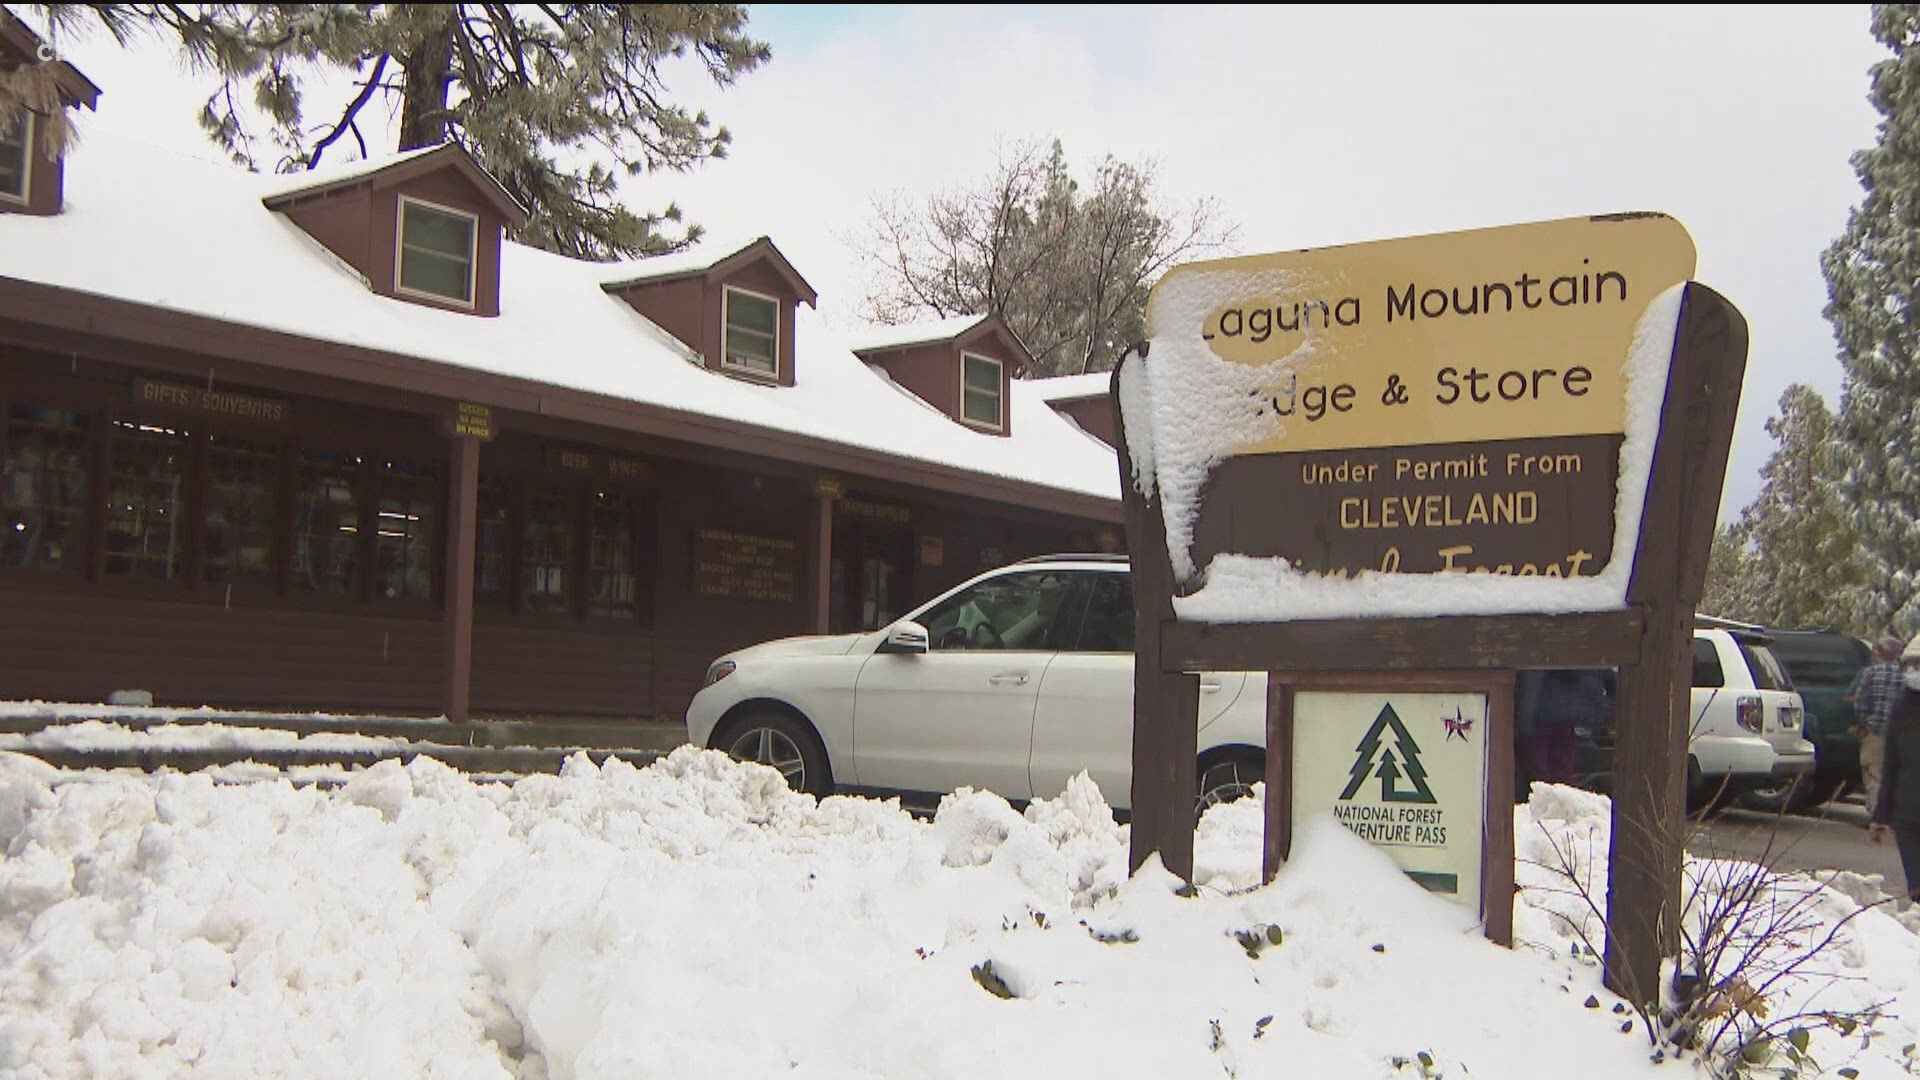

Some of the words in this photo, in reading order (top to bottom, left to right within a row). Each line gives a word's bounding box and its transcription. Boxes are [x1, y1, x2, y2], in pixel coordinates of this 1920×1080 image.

[1386, 258, 1628, 322] Mountain
[144, 382, 189, 405] GIFTS
[202, 392, 282, 420] SOUVENIRS
[1381, 374, 1409, 406] &
[1436, 365, 1593, 405] Store
[561, 451, 589, 469] BEER
[1302, 459, 1378, 485] Under
[1396, 454, 1488, 481] Permit
[1506, 453, 1582, 474] From
[1340, 490, 1537, 529] CLEVELAND
[1333, 804, 1395, 822] NATIONAL
[1398, 808, 1443, 825] FOREST
[1341, 821, 1412, 842] VENTURE
[1415, 826, 1447, 844] PASS
